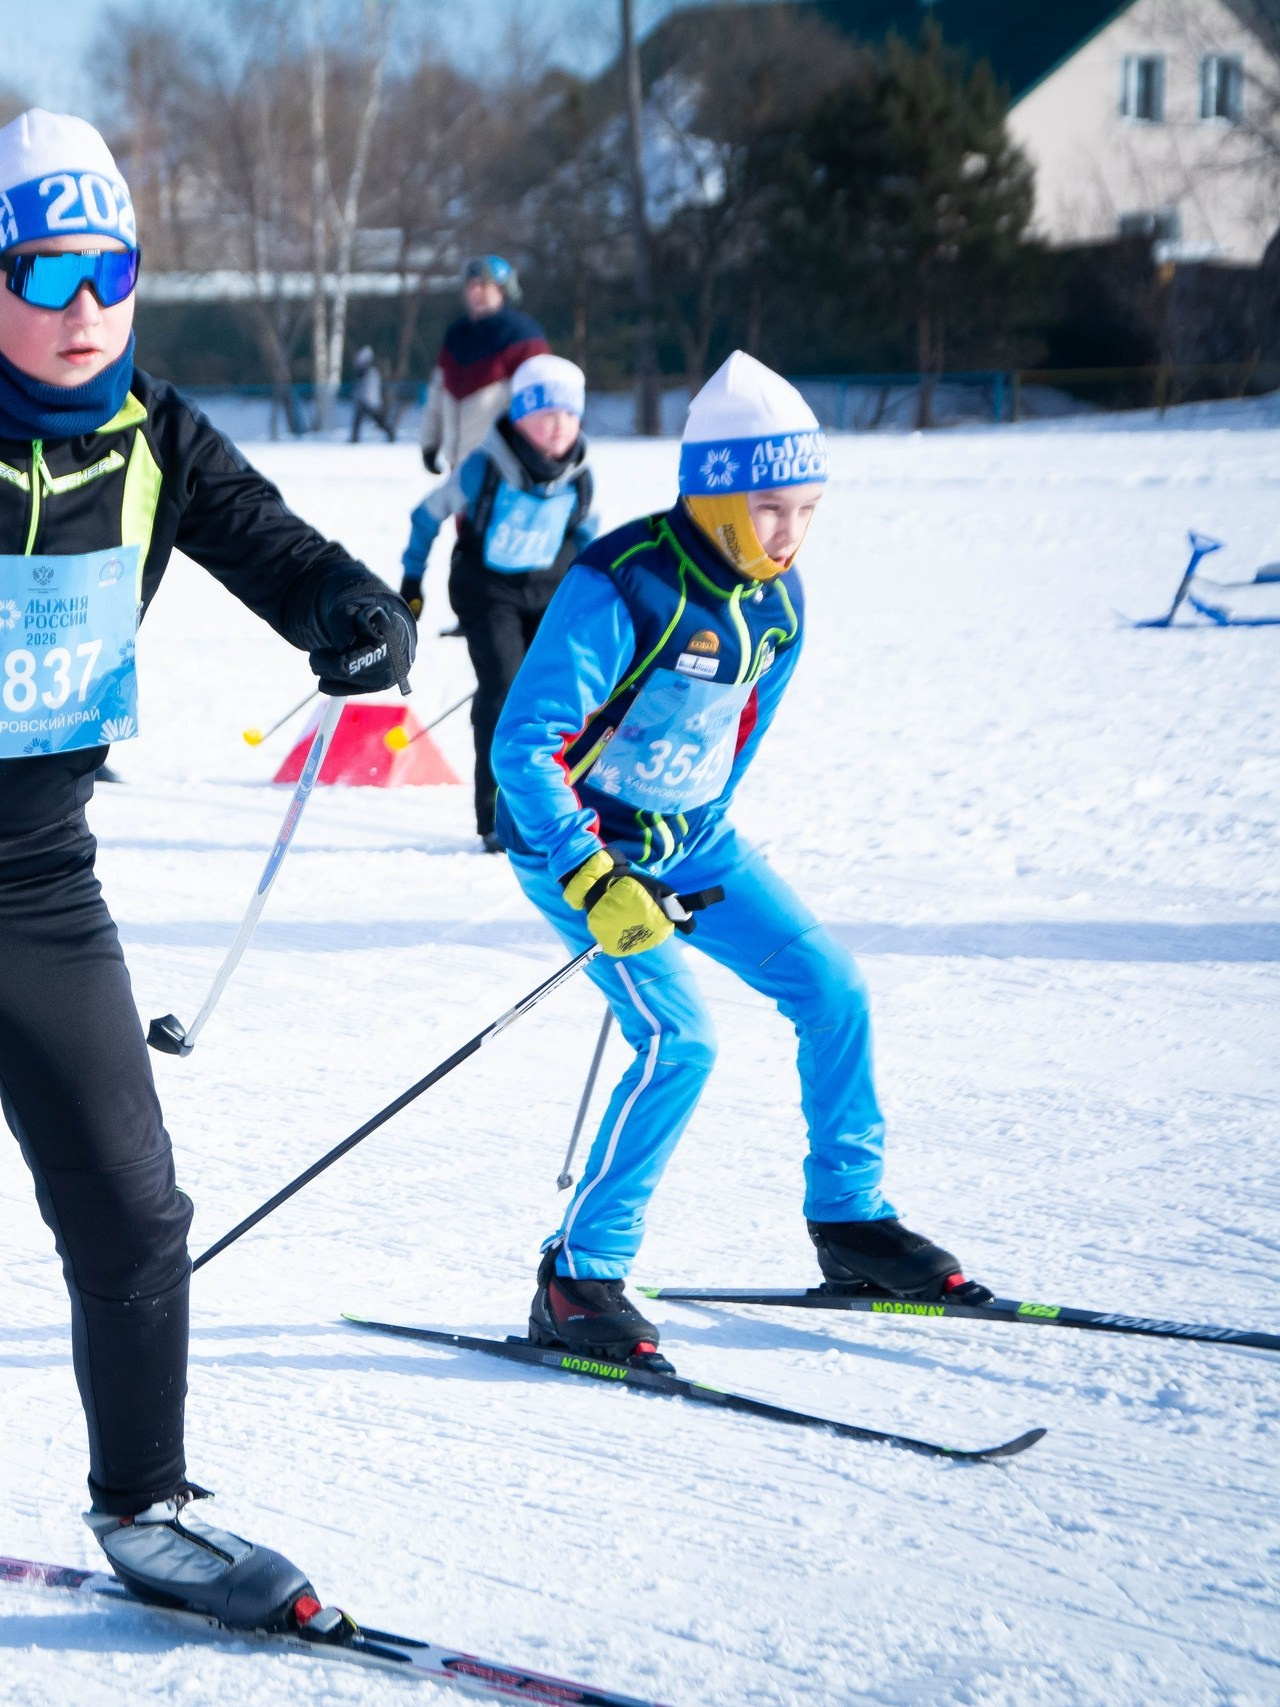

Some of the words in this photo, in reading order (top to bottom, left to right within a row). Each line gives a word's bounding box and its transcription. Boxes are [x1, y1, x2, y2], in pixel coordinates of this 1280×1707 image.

[24, 595, 89, 615] ЛЫЖНЯ
[24, 610, 88, 629] РОССИИ
[26, 632, 57, 645] 2026
[348, 643, 387, 675] SPORT
[67, 705, 101, 724] КРАЙ
[872, 1301, 945, 1317] NORDWAY
[1091, 1314, 1242, 1340] NORDWAY
[561, 1356, 628, 1380] NORDWAY
